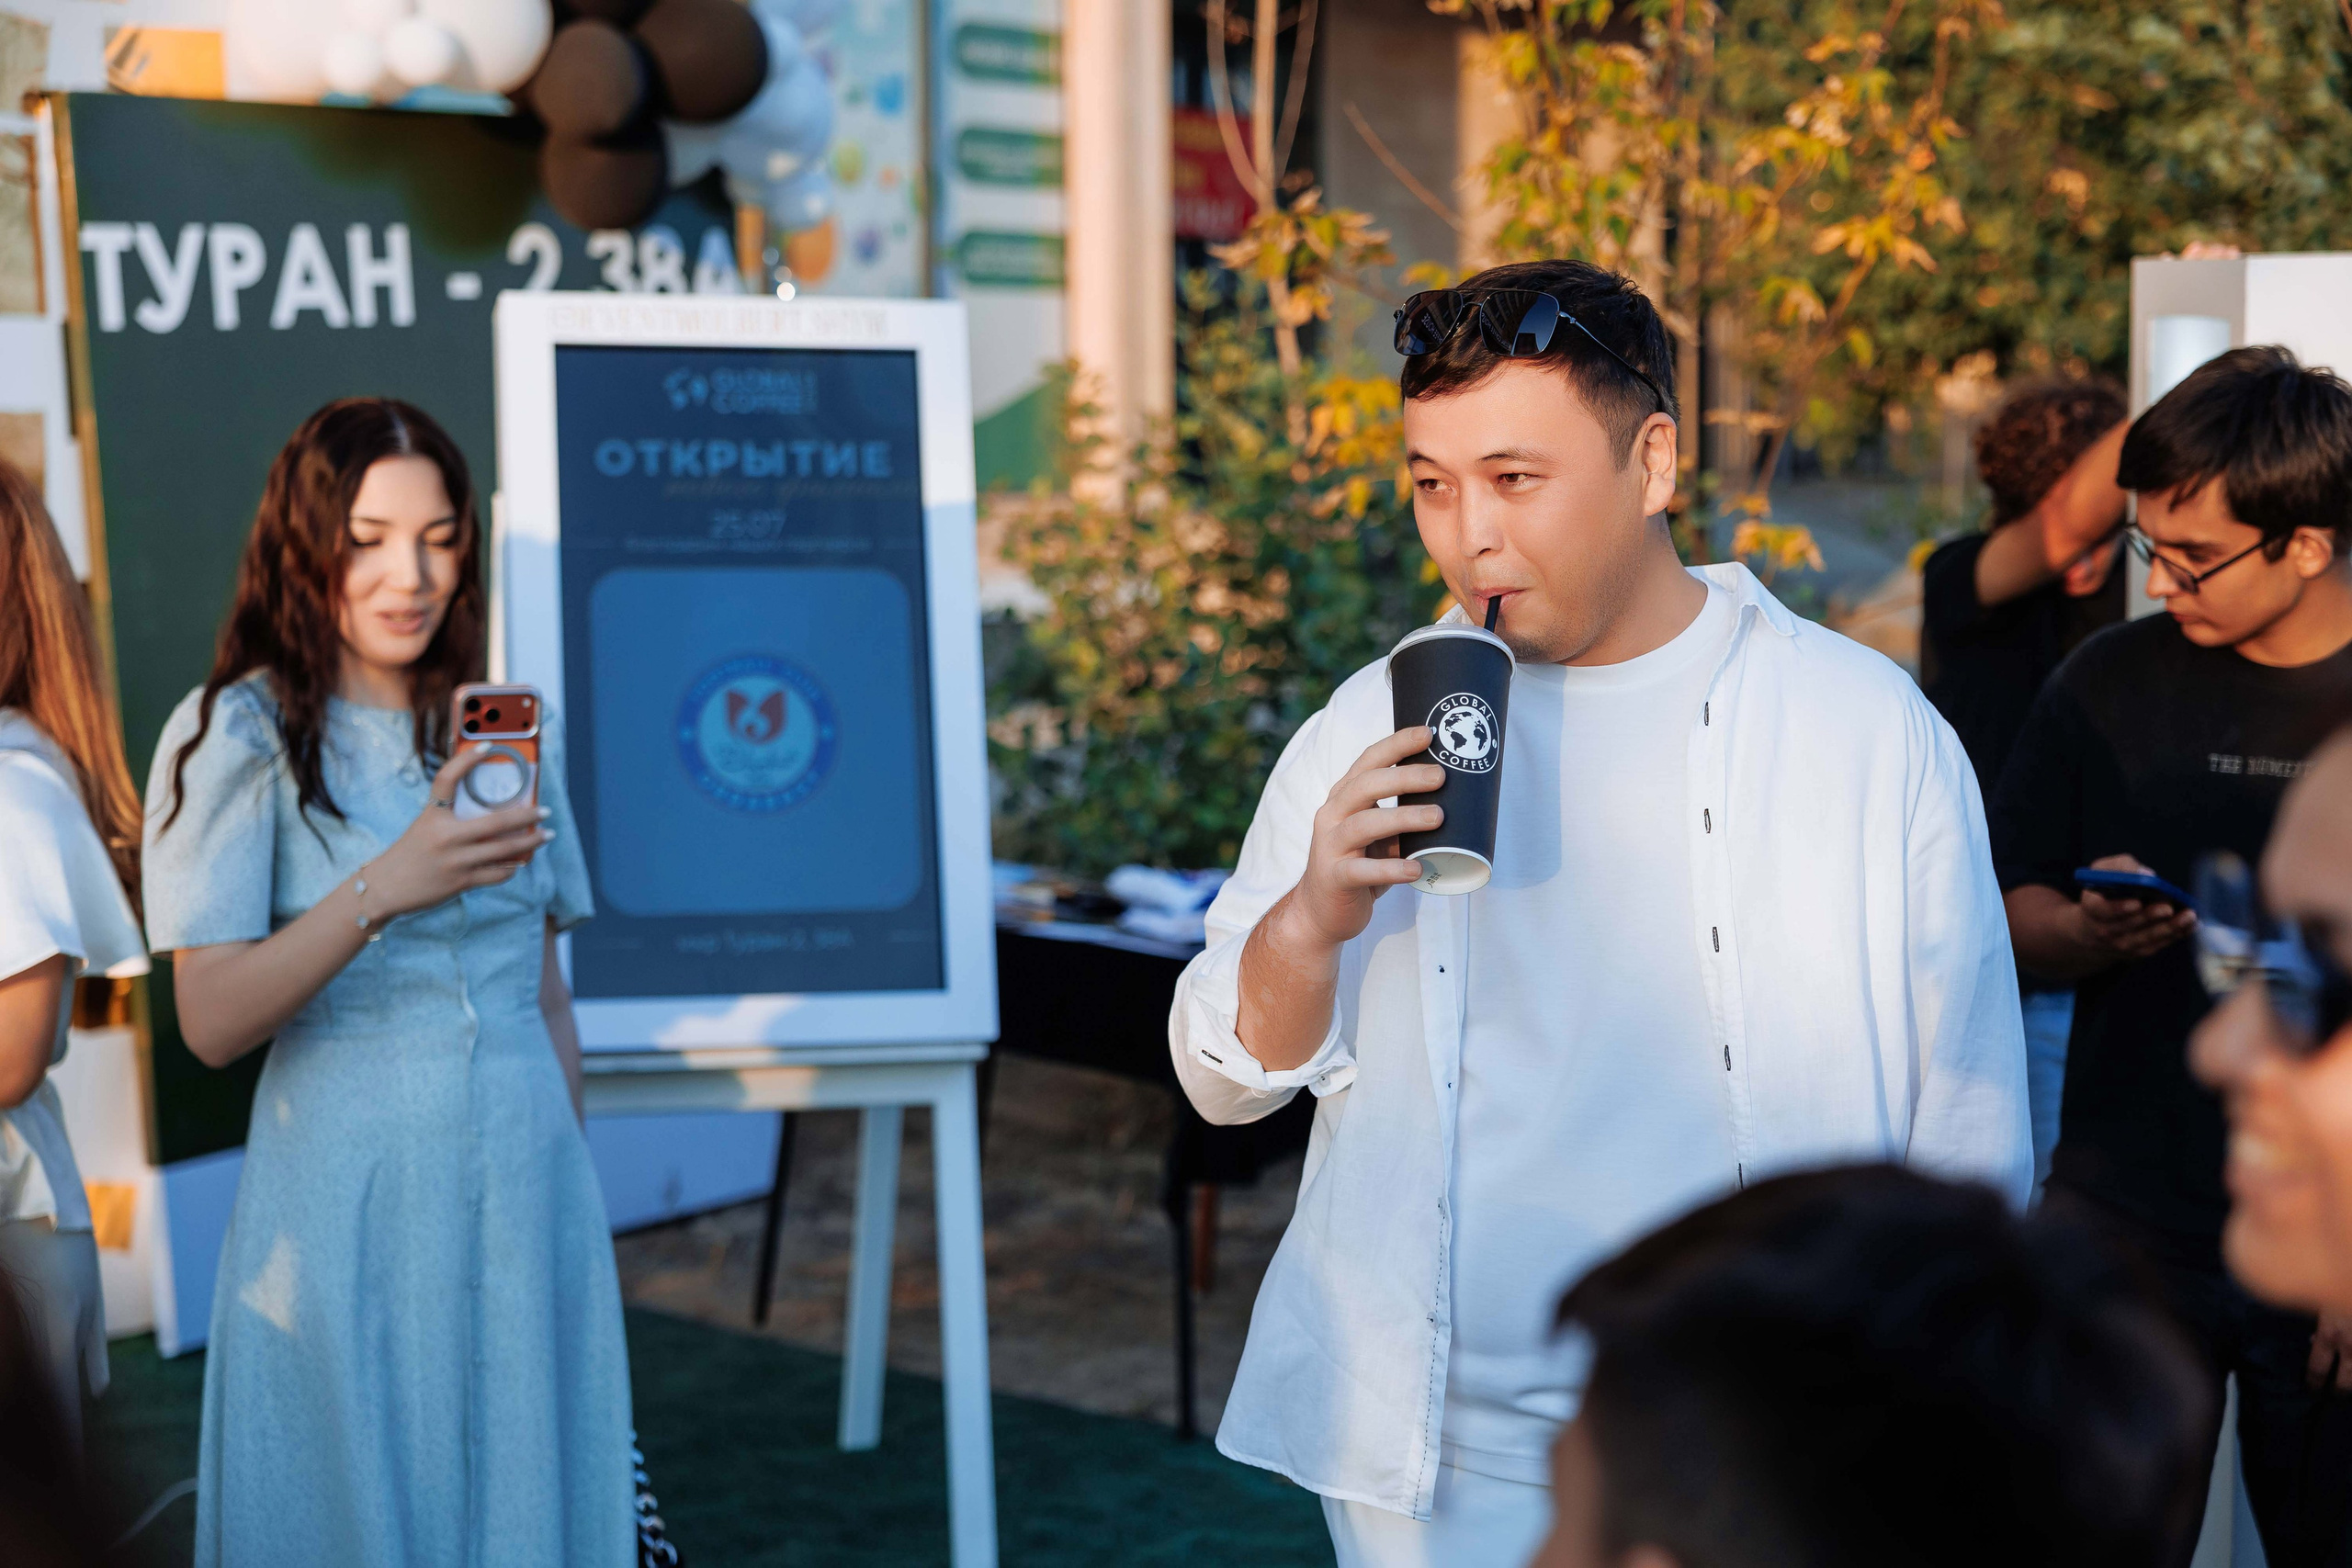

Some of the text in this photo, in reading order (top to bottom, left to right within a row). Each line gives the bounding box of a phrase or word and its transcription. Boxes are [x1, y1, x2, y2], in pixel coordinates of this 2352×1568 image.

[79, 220, 416, 334] ТУРАН
[506, 220, 562, 291] 2
[594, 438, 894, 479] ОТКРЫТИЕ
[1440, 695, 1492, 721] GLOBAL
[1439, 750, 1490, 771] COFFEE
